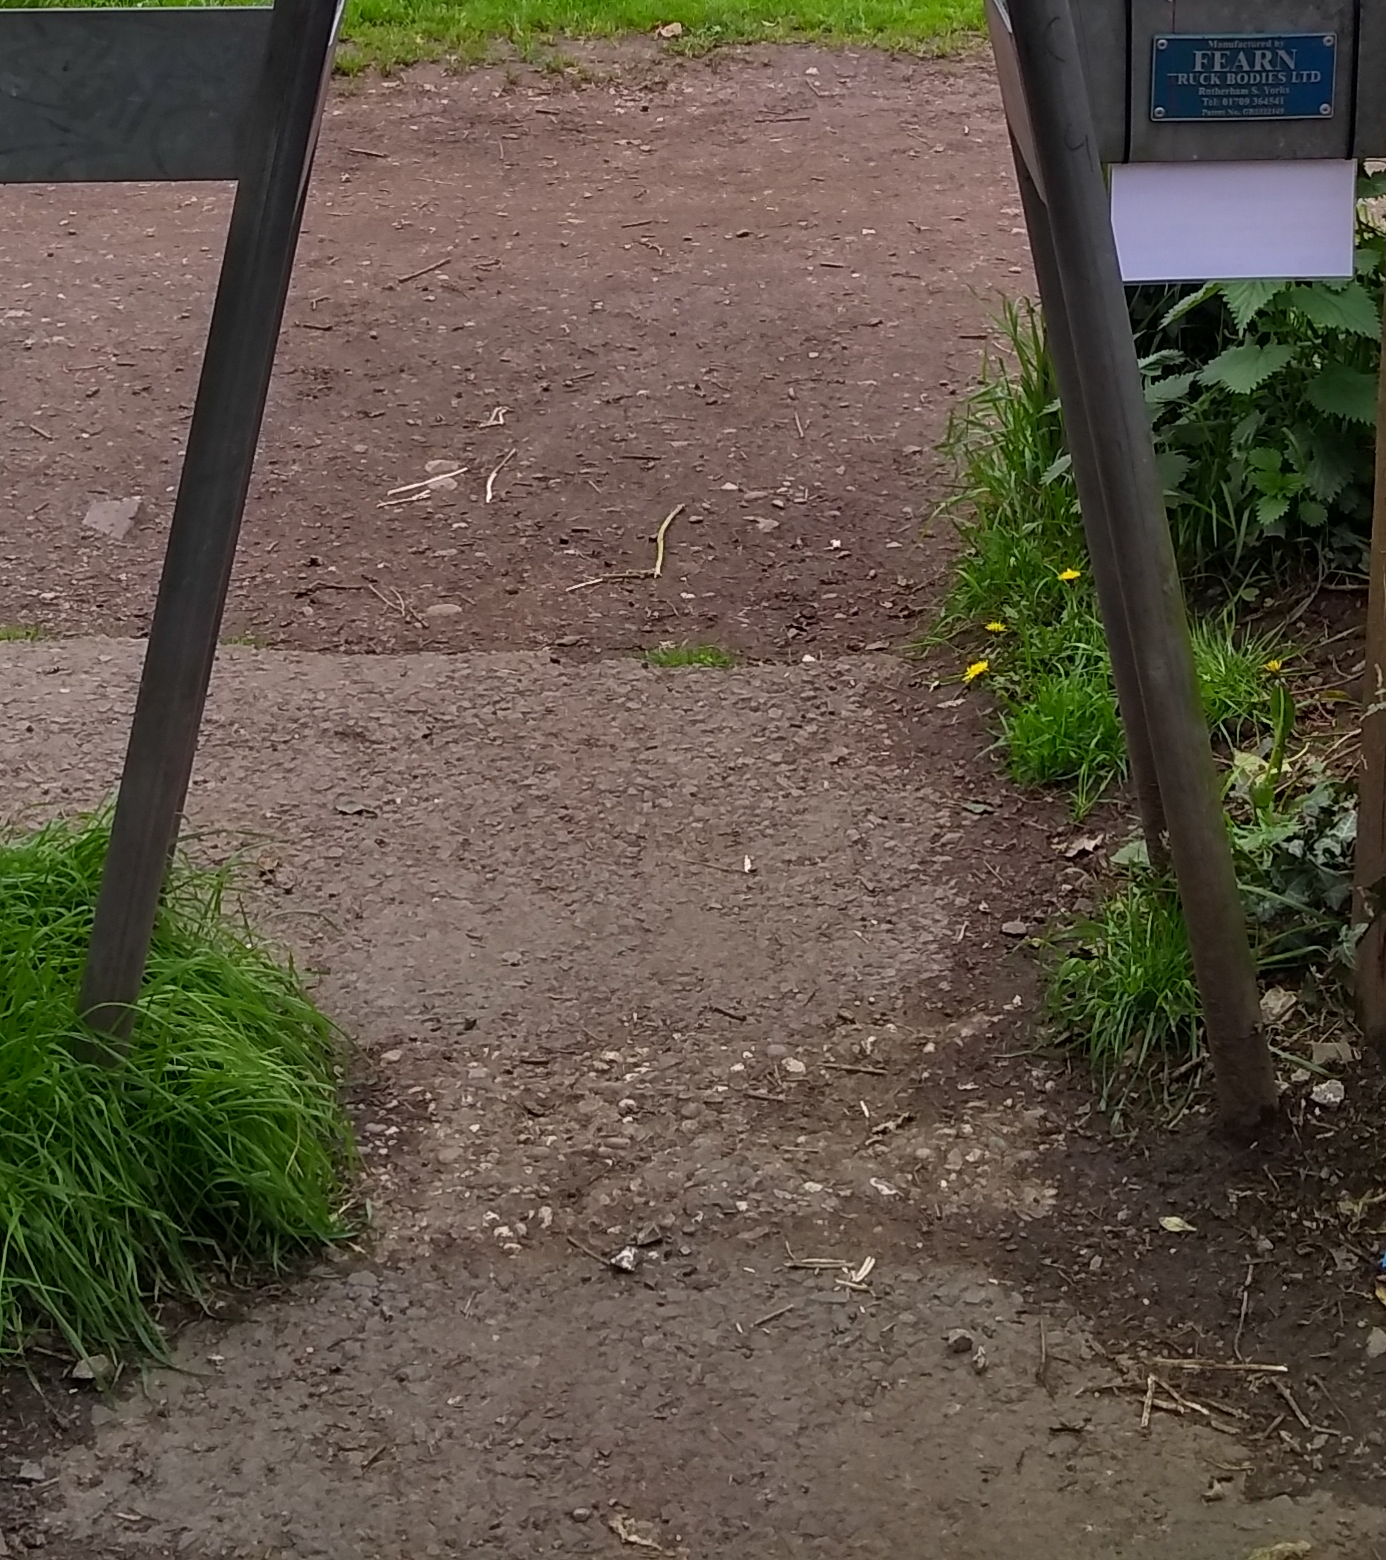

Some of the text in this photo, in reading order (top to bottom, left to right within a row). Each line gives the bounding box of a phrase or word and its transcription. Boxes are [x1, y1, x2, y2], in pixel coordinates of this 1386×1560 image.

[1208, 40, 1284, 49] Manufactured by
[1193, 49, 1298, 71] FEARN
[1226, 71, 1287, 85] BODIES
[1290, 70, 1322, 84] LTD
[1198, 86, 1249, 96] Rotherham
[1264, 86, 1290, 95] Yorks
[1222, 97, 1252, 106] 01709
[1253, 96, 1285, 106] 364541
